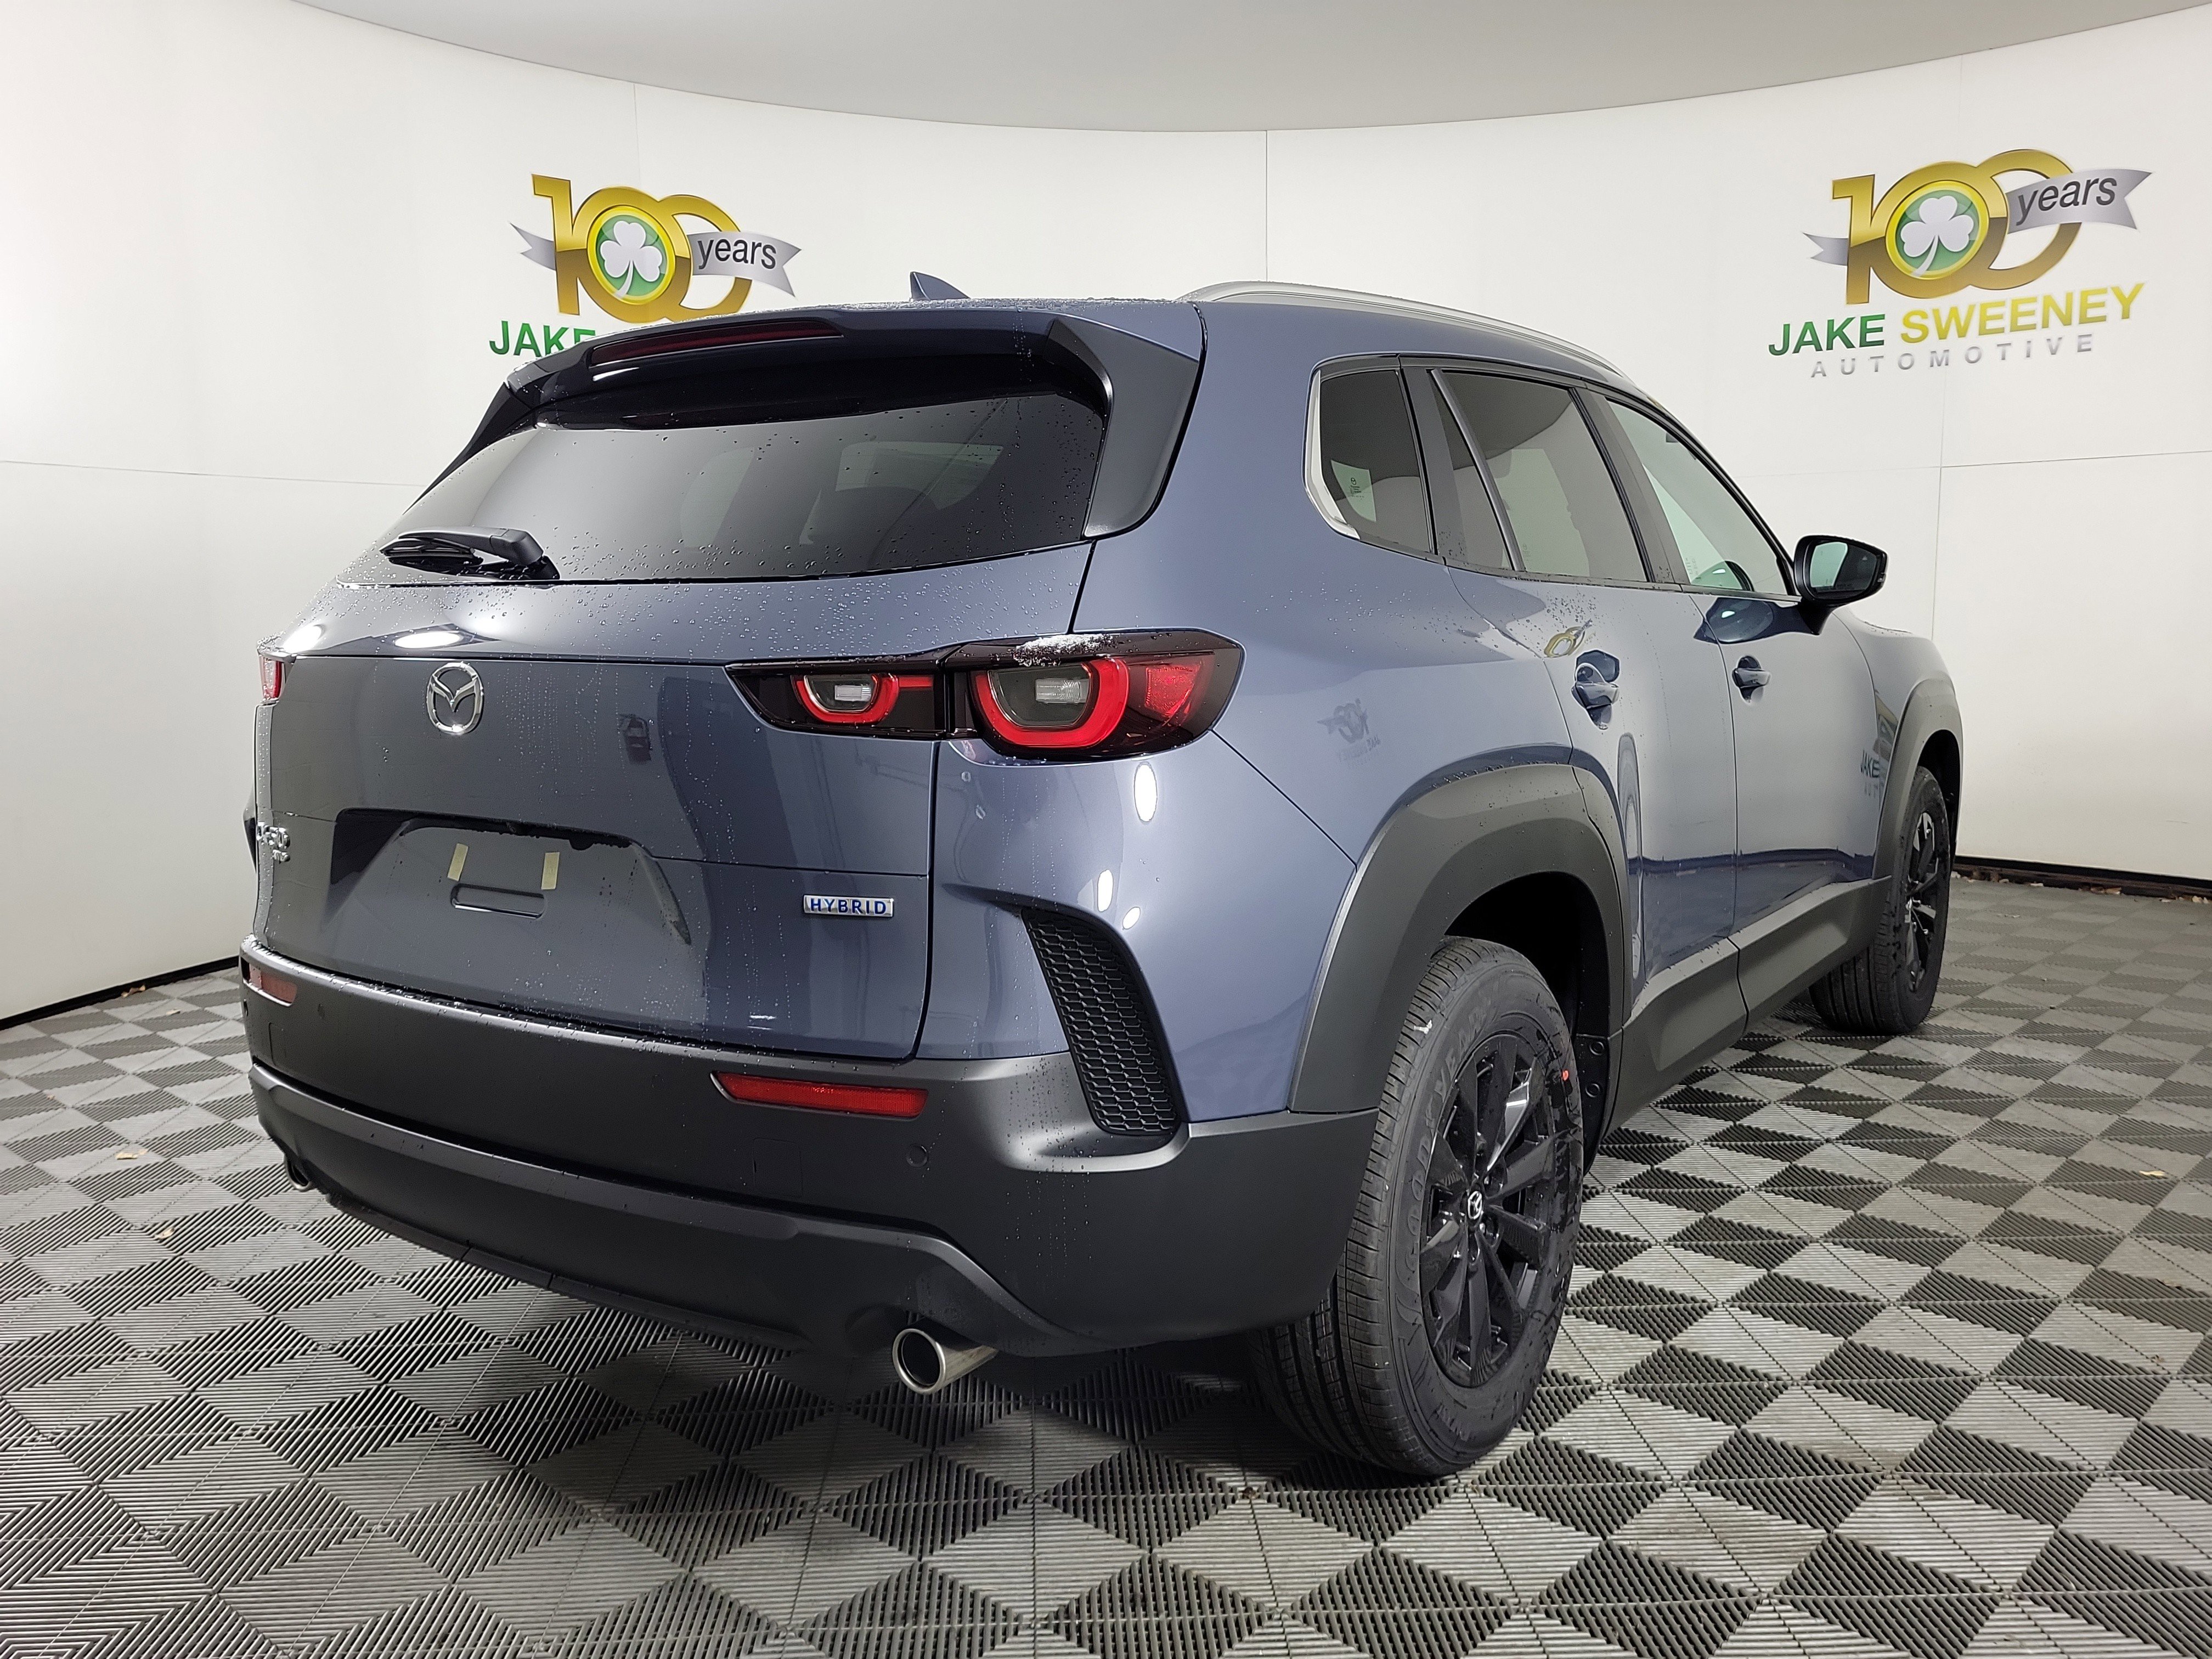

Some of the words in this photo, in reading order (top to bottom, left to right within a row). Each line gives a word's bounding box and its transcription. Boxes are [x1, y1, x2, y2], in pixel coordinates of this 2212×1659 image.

[2015, 177, 2118, 225] years
[531, 173, 752, 324] 100
[1832, 149, 2084, 304] 100
[698, 238, 777, 270] years
[1768, 314, 1886, 356] JAKE
[1901, 283, 2145, 343] SWEENEY
[1811, 334, 2094, 377] AUTOMOTIVE
[810, 898, 887, 914] HYBRID
